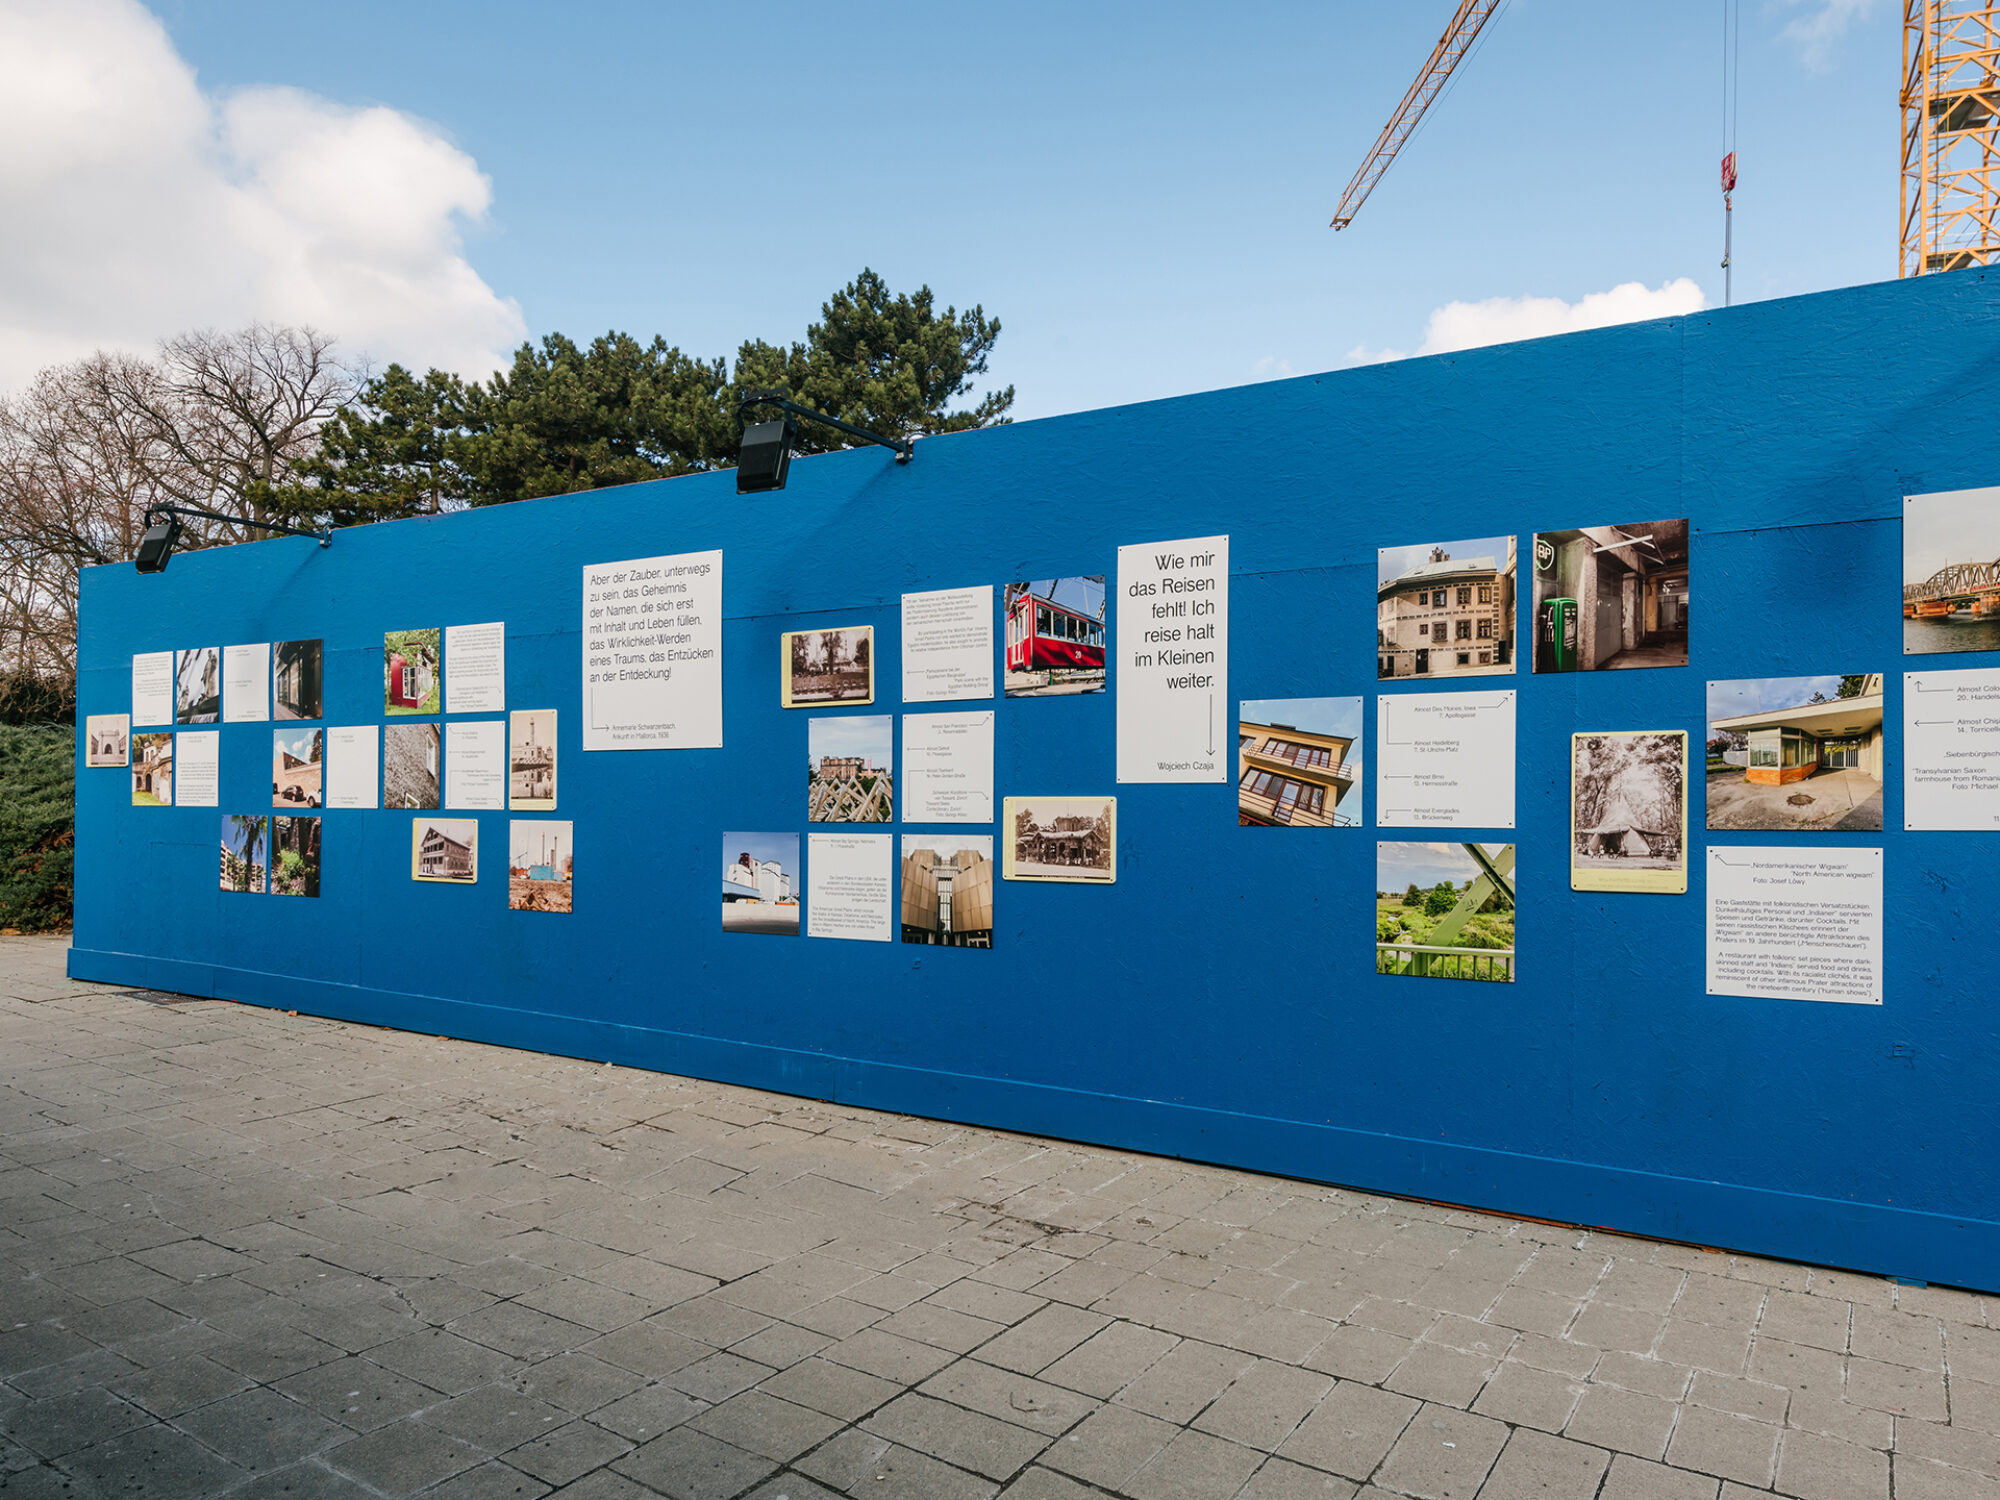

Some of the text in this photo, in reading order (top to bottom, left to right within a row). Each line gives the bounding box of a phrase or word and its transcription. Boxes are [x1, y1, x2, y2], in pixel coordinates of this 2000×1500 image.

[1155, 551, 1215, 570] Wie mir
[1538, 545, 1550, 559] BP
[590, 575, 610, 586] Aber
[613, 572, 627, 584] der
[664, 564, 710, 577] unterwegs
[590, 594, 599, 602] zu
[623, 587, 638, 599] das
[641, 581, 687, 598] Geheimnis
[1129, 577, 1215, 597] das Reisen
[590, 607, 604, 618] der
[641, 602, 653, 614] die
[656, 600, 673, 612] sich
[676, 598, 693, 610] erst
[1152, 599, 1215, 619] fehlt! Ich
[590, 623, 602, 634] mit
[604, 621, 626, 632] Inhalt
[629, 619, 644, 631] und
[648, 618, 674, 629] Leben
[1145, 624, 1215, 643] reise halt
[590, 632, 691, 650] das Wirklichkeit-Werden
[590, 655, 611, 667] eines
[649, 651, 665, 663] das
[668, 648, 713, 661] Entzücken
[1135, 649, 1214, 667] im Kleinen
[590, 667, 671, 683] an der Entdeckung!
[1167, 673, 1214, 689] weiter.
[1157, 761, 1214, 772] Wojciech Czaja
